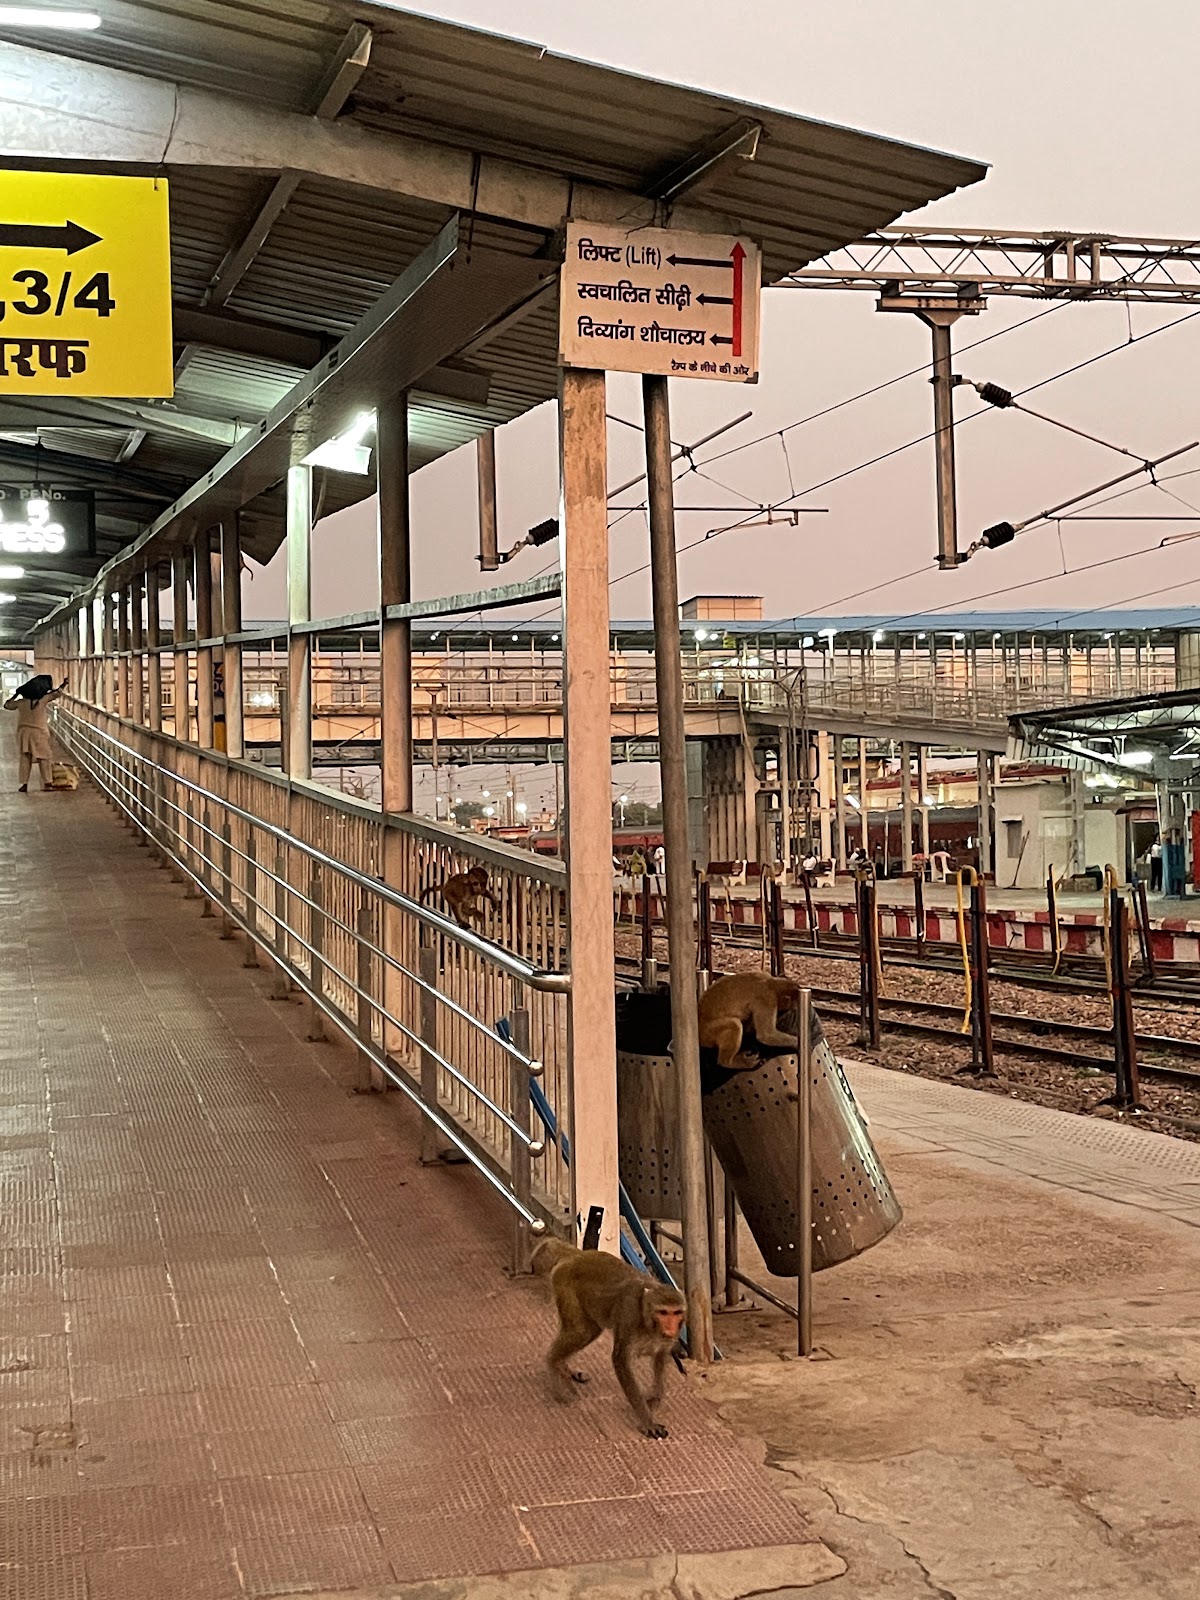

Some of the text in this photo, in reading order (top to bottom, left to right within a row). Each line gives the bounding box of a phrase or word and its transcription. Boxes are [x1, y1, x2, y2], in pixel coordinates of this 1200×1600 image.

[577, 238, 662, 270] लिफ्ट (Lift)
[577, 280, 692, 311] स्वचालित सीढ़ी
[577, 316, 706, 346] दिव्यांग शौचालय
